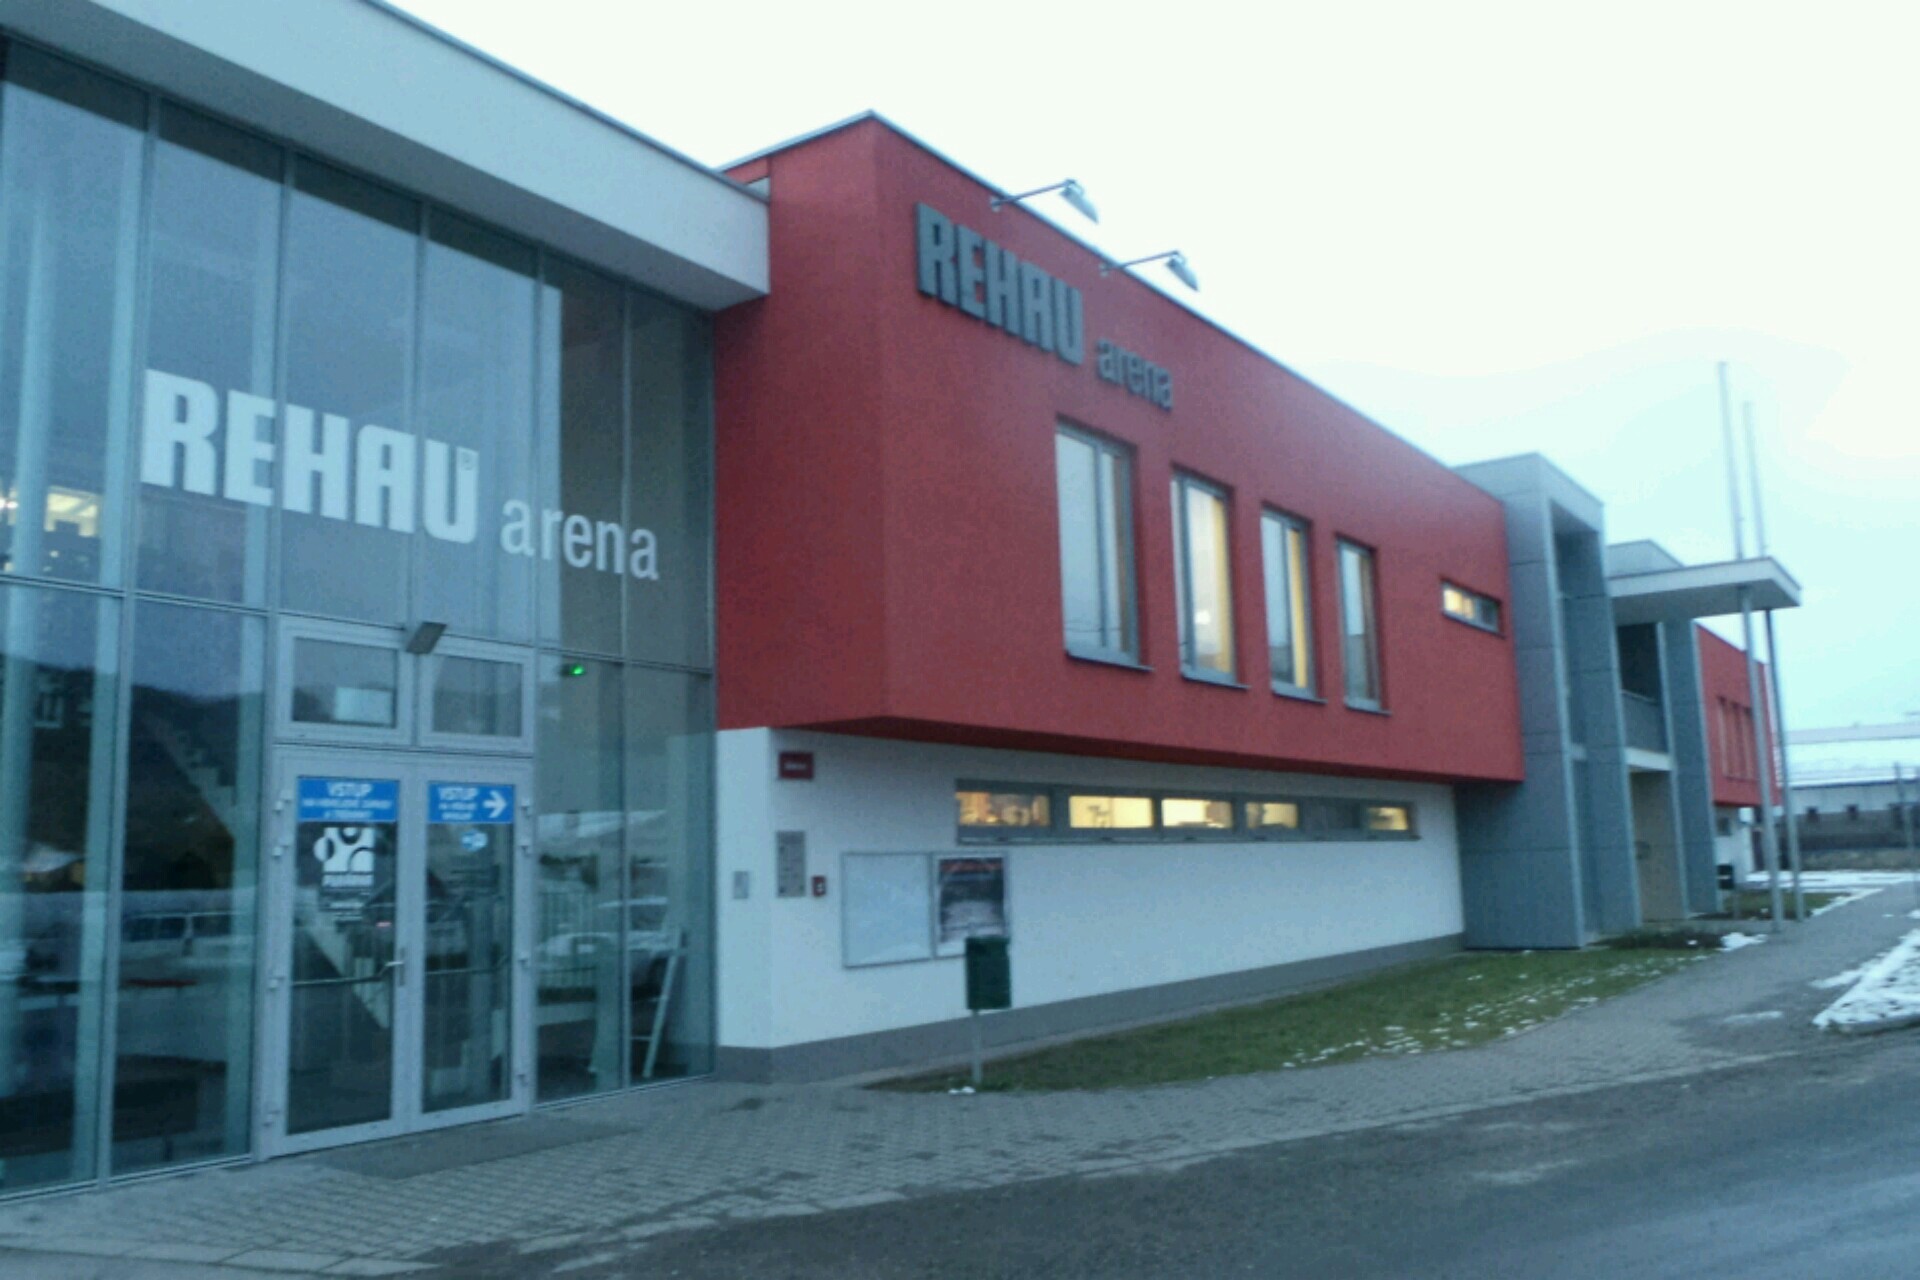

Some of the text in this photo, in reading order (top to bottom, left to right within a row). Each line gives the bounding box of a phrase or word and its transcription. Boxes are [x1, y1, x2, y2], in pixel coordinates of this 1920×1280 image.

[915, 201, 1174, 412] REHAU arena
[140, 368, 659, 581] REHAU arena
